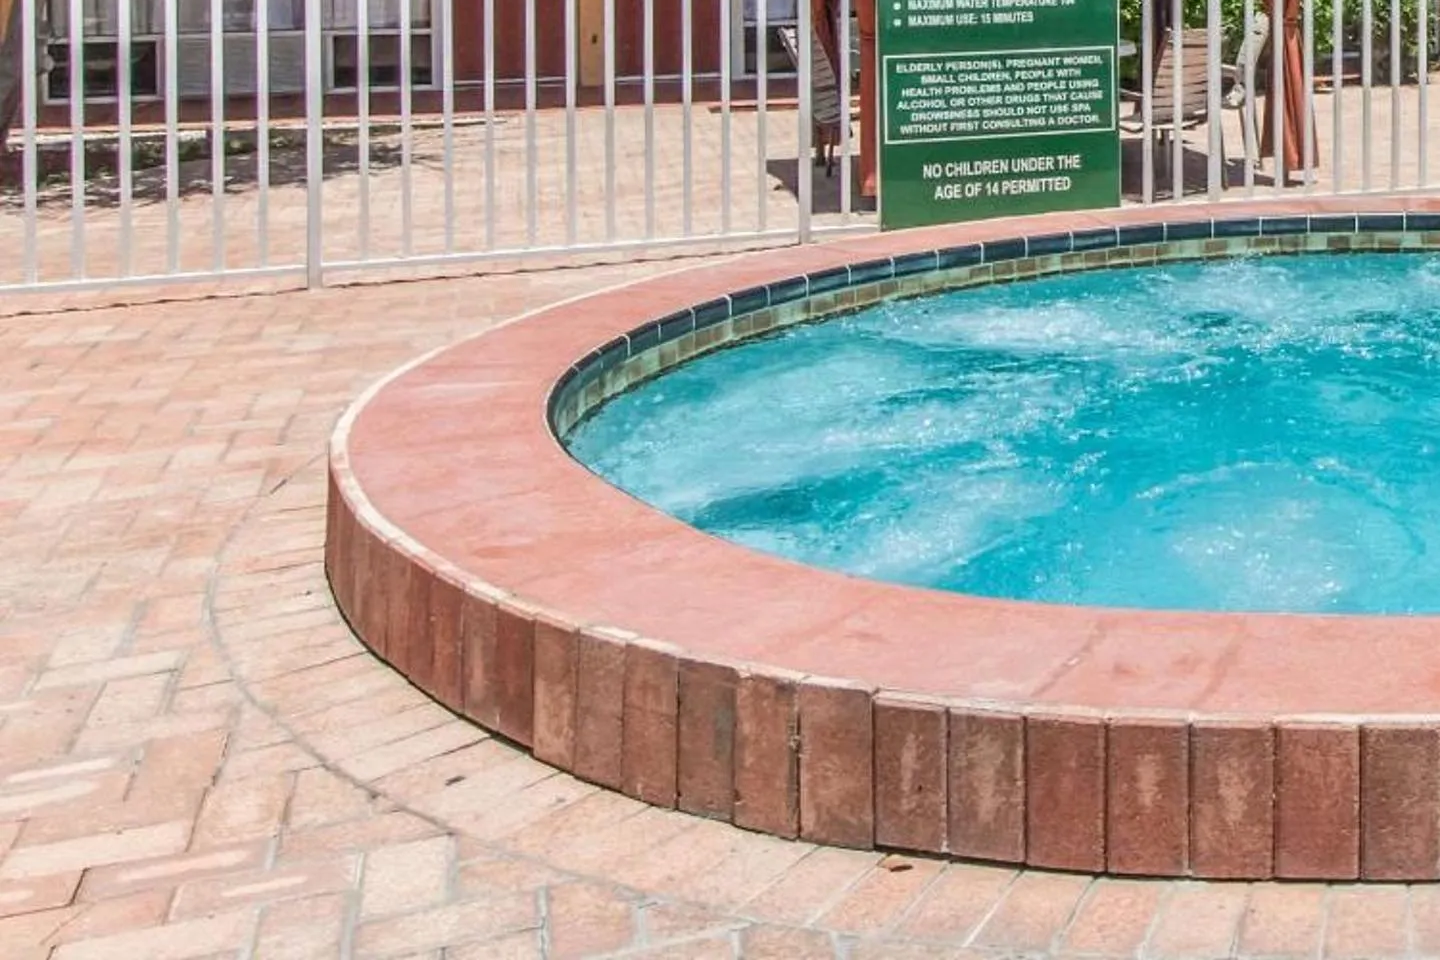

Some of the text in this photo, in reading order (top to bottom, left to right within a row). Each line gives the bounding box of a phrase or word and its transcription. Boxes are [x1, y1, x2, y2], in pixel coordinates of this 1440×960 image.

[908, 0, 954, 10] MAXIMUM
[908, 11, 1033, 27] MAXIMUM USE: 15 MINUTES
[896, 62, 943, 74] ELDERLY
[1005, 57, 1061, 68] PREGNANT
[921, 74, 956, 85] SMALL
[1014, 69, 1054, 80] PEOPLE
[1056, 68, 1081, 78] WITH
[902, 78, 1099, 97] HEALTH PROBLEMS AND PEOPLE USING
[896, 90, 1103, 110] ALCOHOL OR OTHER DRUGS THAT CAUSE
[982, 106, 1024, 118] SHOULD
[1026, 104, 1047, 115] NOT
[1049, 103, 1069, 113] USE
[1071, 102, 1091, 113] SPA
[900, 123, 947, 135] WITHOUT
[950, 121, 979, 132] FIRST
[982, 117, 1046, 129] CONSULTING
[1048, 117, 1055, 127] A
[922, 154, 1081, 179] NO CHILDREN UNDER THE
[934, 176, 1072, 200] AGE OF 14 PERMITTED
